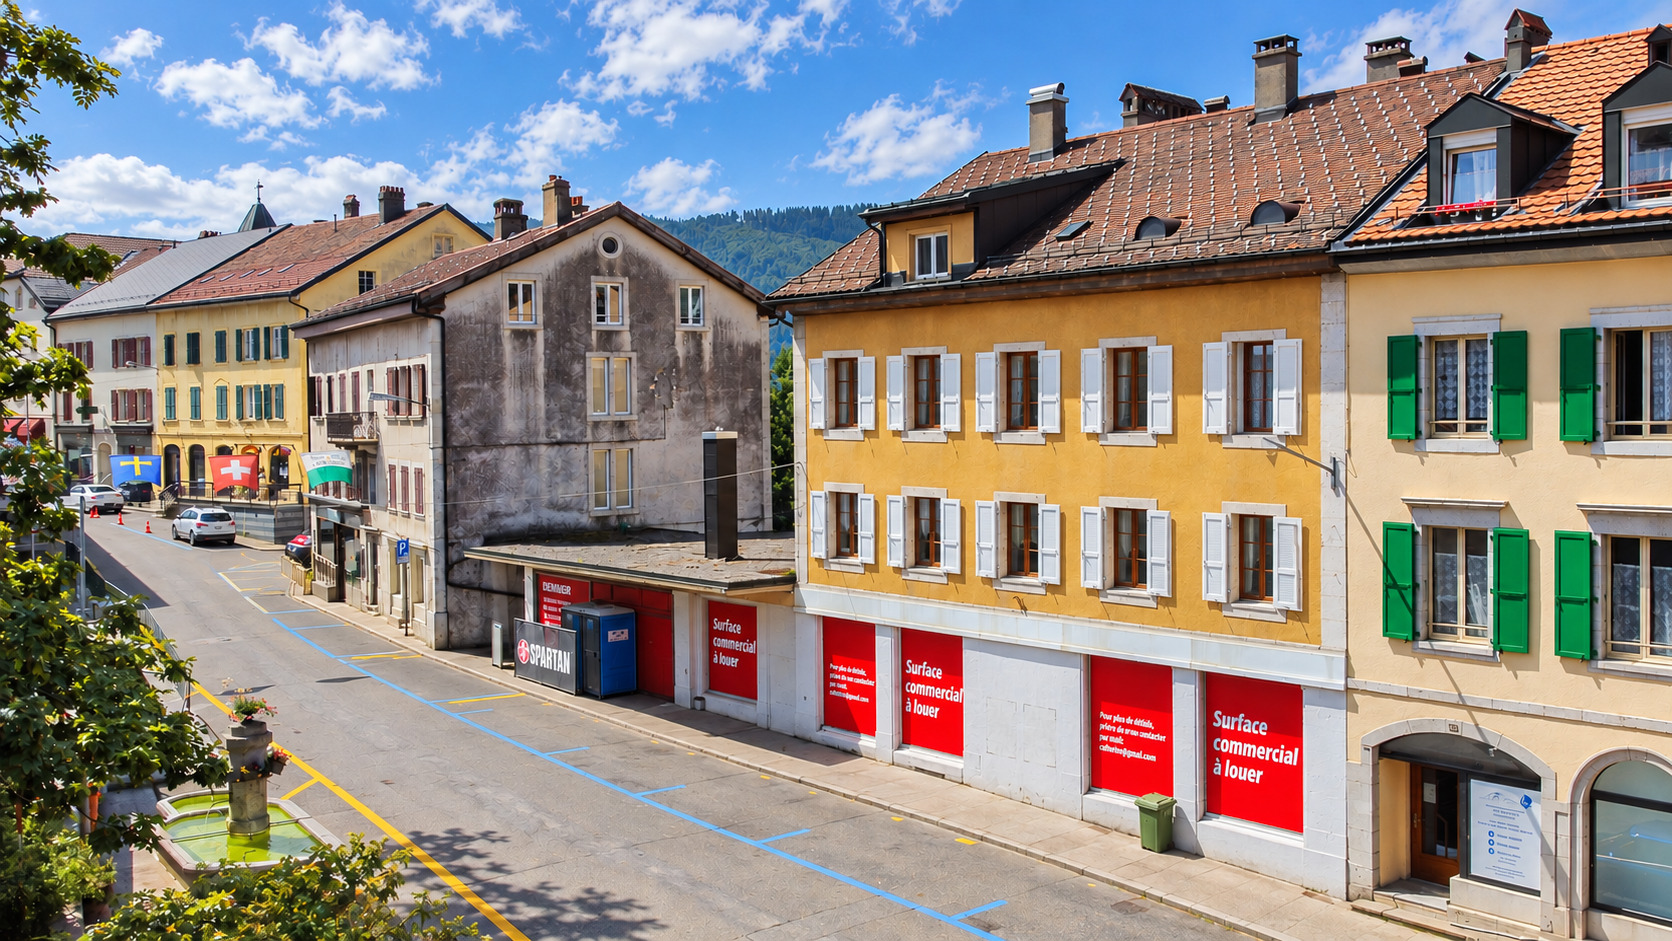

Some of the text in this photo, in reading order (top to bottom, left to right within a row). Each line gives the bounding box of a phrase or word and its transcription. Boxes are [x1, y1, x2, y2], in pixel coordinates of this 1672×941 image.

[400, 542, 406, 555] P
[713, 618, 741, 634] Surface
[713, 637, 756, 654] commercial
[530, 643, 570, 675] SPARTAN
[713, 651, 739, 667] à louer
[905, 659, 943, 680] Surface
[905, 682, 964, 703] commercial
[905, 698, 940, 719] à louer
[1212, 710, 1268, 736] Surface
[1212, 737, 1299, 766] commercial
[1213, 757, 1264, 784] à louer
